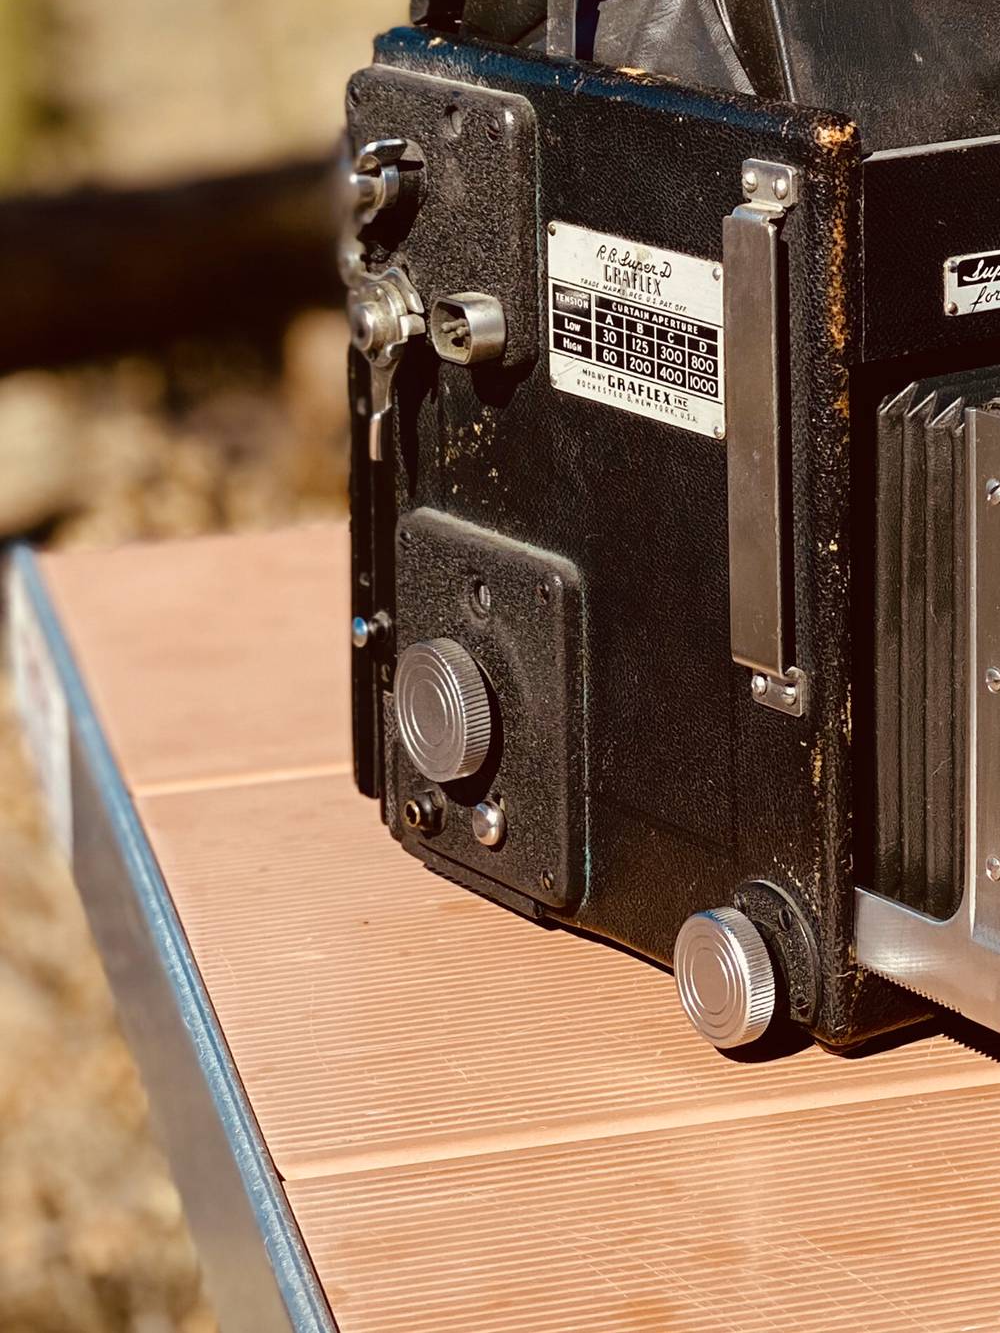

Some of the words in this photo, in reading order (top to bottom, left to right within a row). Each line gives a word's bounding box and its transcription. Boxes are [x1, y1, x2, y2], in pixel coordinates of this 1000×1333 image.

[618, 251, 659, 277] Super
[660, 261, 672, 279] D
[604, 264, 661, 297] GRAFLEX
[555, 292, 589, 309] TENSION
[612, 302, 649, 320] CURTAIN
[651, 314, 699, 334] APERTURE
[605, 314, 614, 326] A
[603, 329, 617, 344] 30
[636, 323, 644, 334] B
[632, 338, 649, 354] 125
[667, 333, 675, 343] C
[699, 341, 707, 353] D
[603, 349, 617, 364] 60
[660, 346, 683, 364] 300
[629, 357, 652, 375] 200
[691, 355, 714, 374] 800
[660, 367, 683, 384] 400
[690, 375, 716, 394] 1000
[576, 379, 623, 399] ROCHESTER
[635, 398, 651, 408] NEW
[608, 374, 671, 406] GRAFLEX
